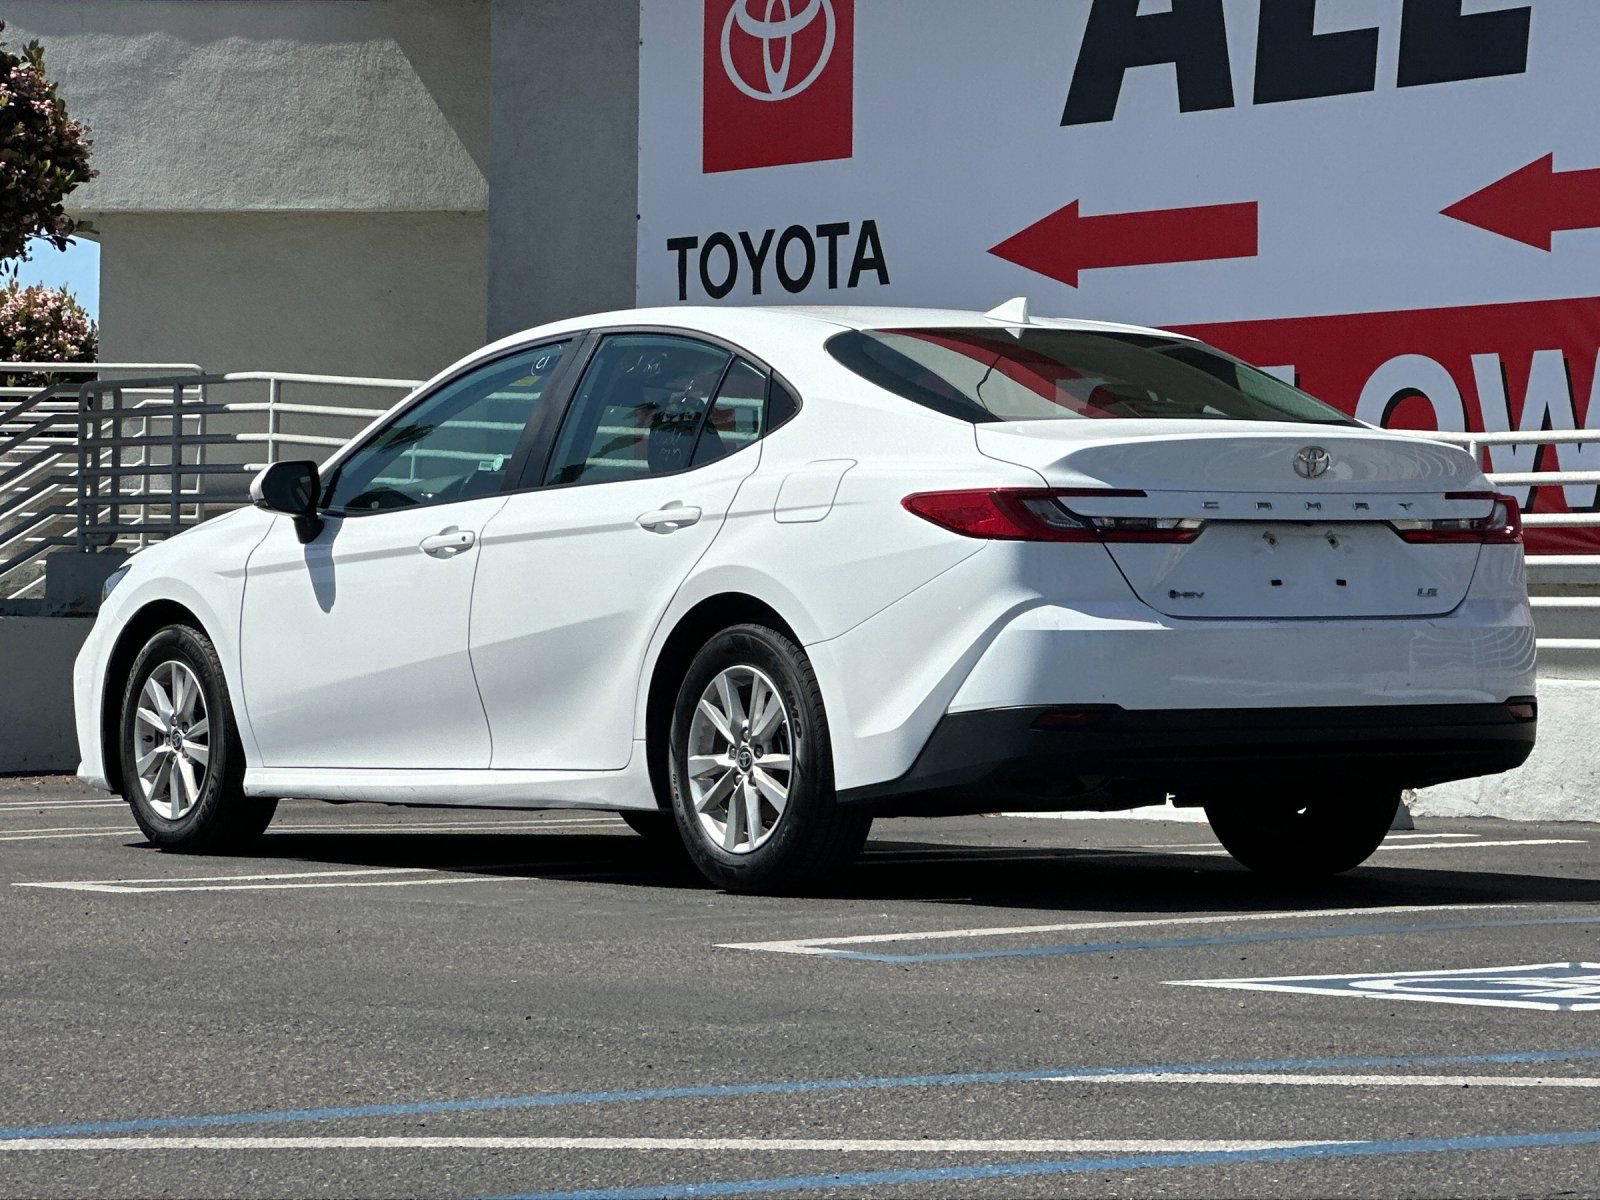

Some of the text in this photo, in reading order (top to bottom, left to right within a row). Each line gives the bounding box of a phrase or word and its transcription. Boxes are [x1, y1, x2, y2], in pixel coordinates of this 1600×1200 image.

[666, 219, 891, 301] TOYOTA
[1201, 501, 1414, 510] CAMRY
[1417, 587, 1438, 597] LE
